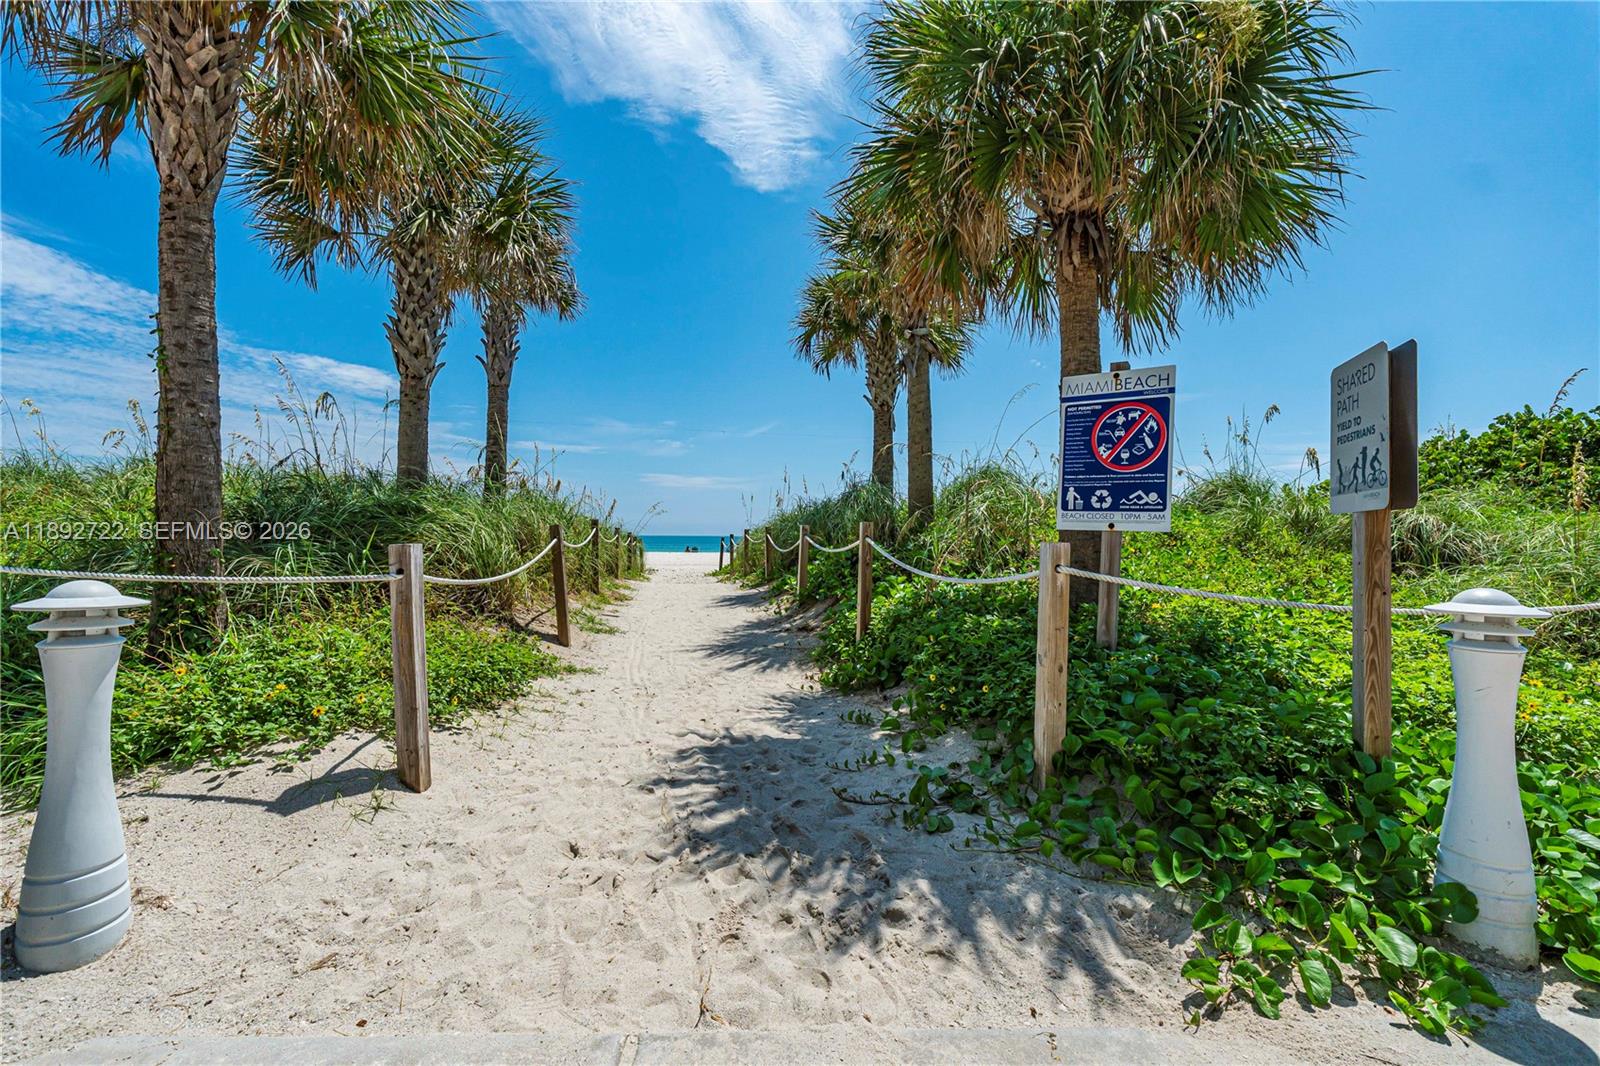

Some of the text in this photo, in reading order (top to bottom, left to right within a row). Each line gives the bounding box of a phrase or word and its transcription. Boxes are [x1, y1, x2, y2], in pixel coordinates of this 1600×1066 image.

[1336, 363, 1376, 396] SHARED
[1337, 392, 1360, 417] PATH
[1336, 416, 1362, 433] YIELD TO
[1336, 424, 1376, 446] PEDESTRIANS
[1061, 512, 1084, 520] BEACH
[1086, 512, 1115, 520] CLOSED
